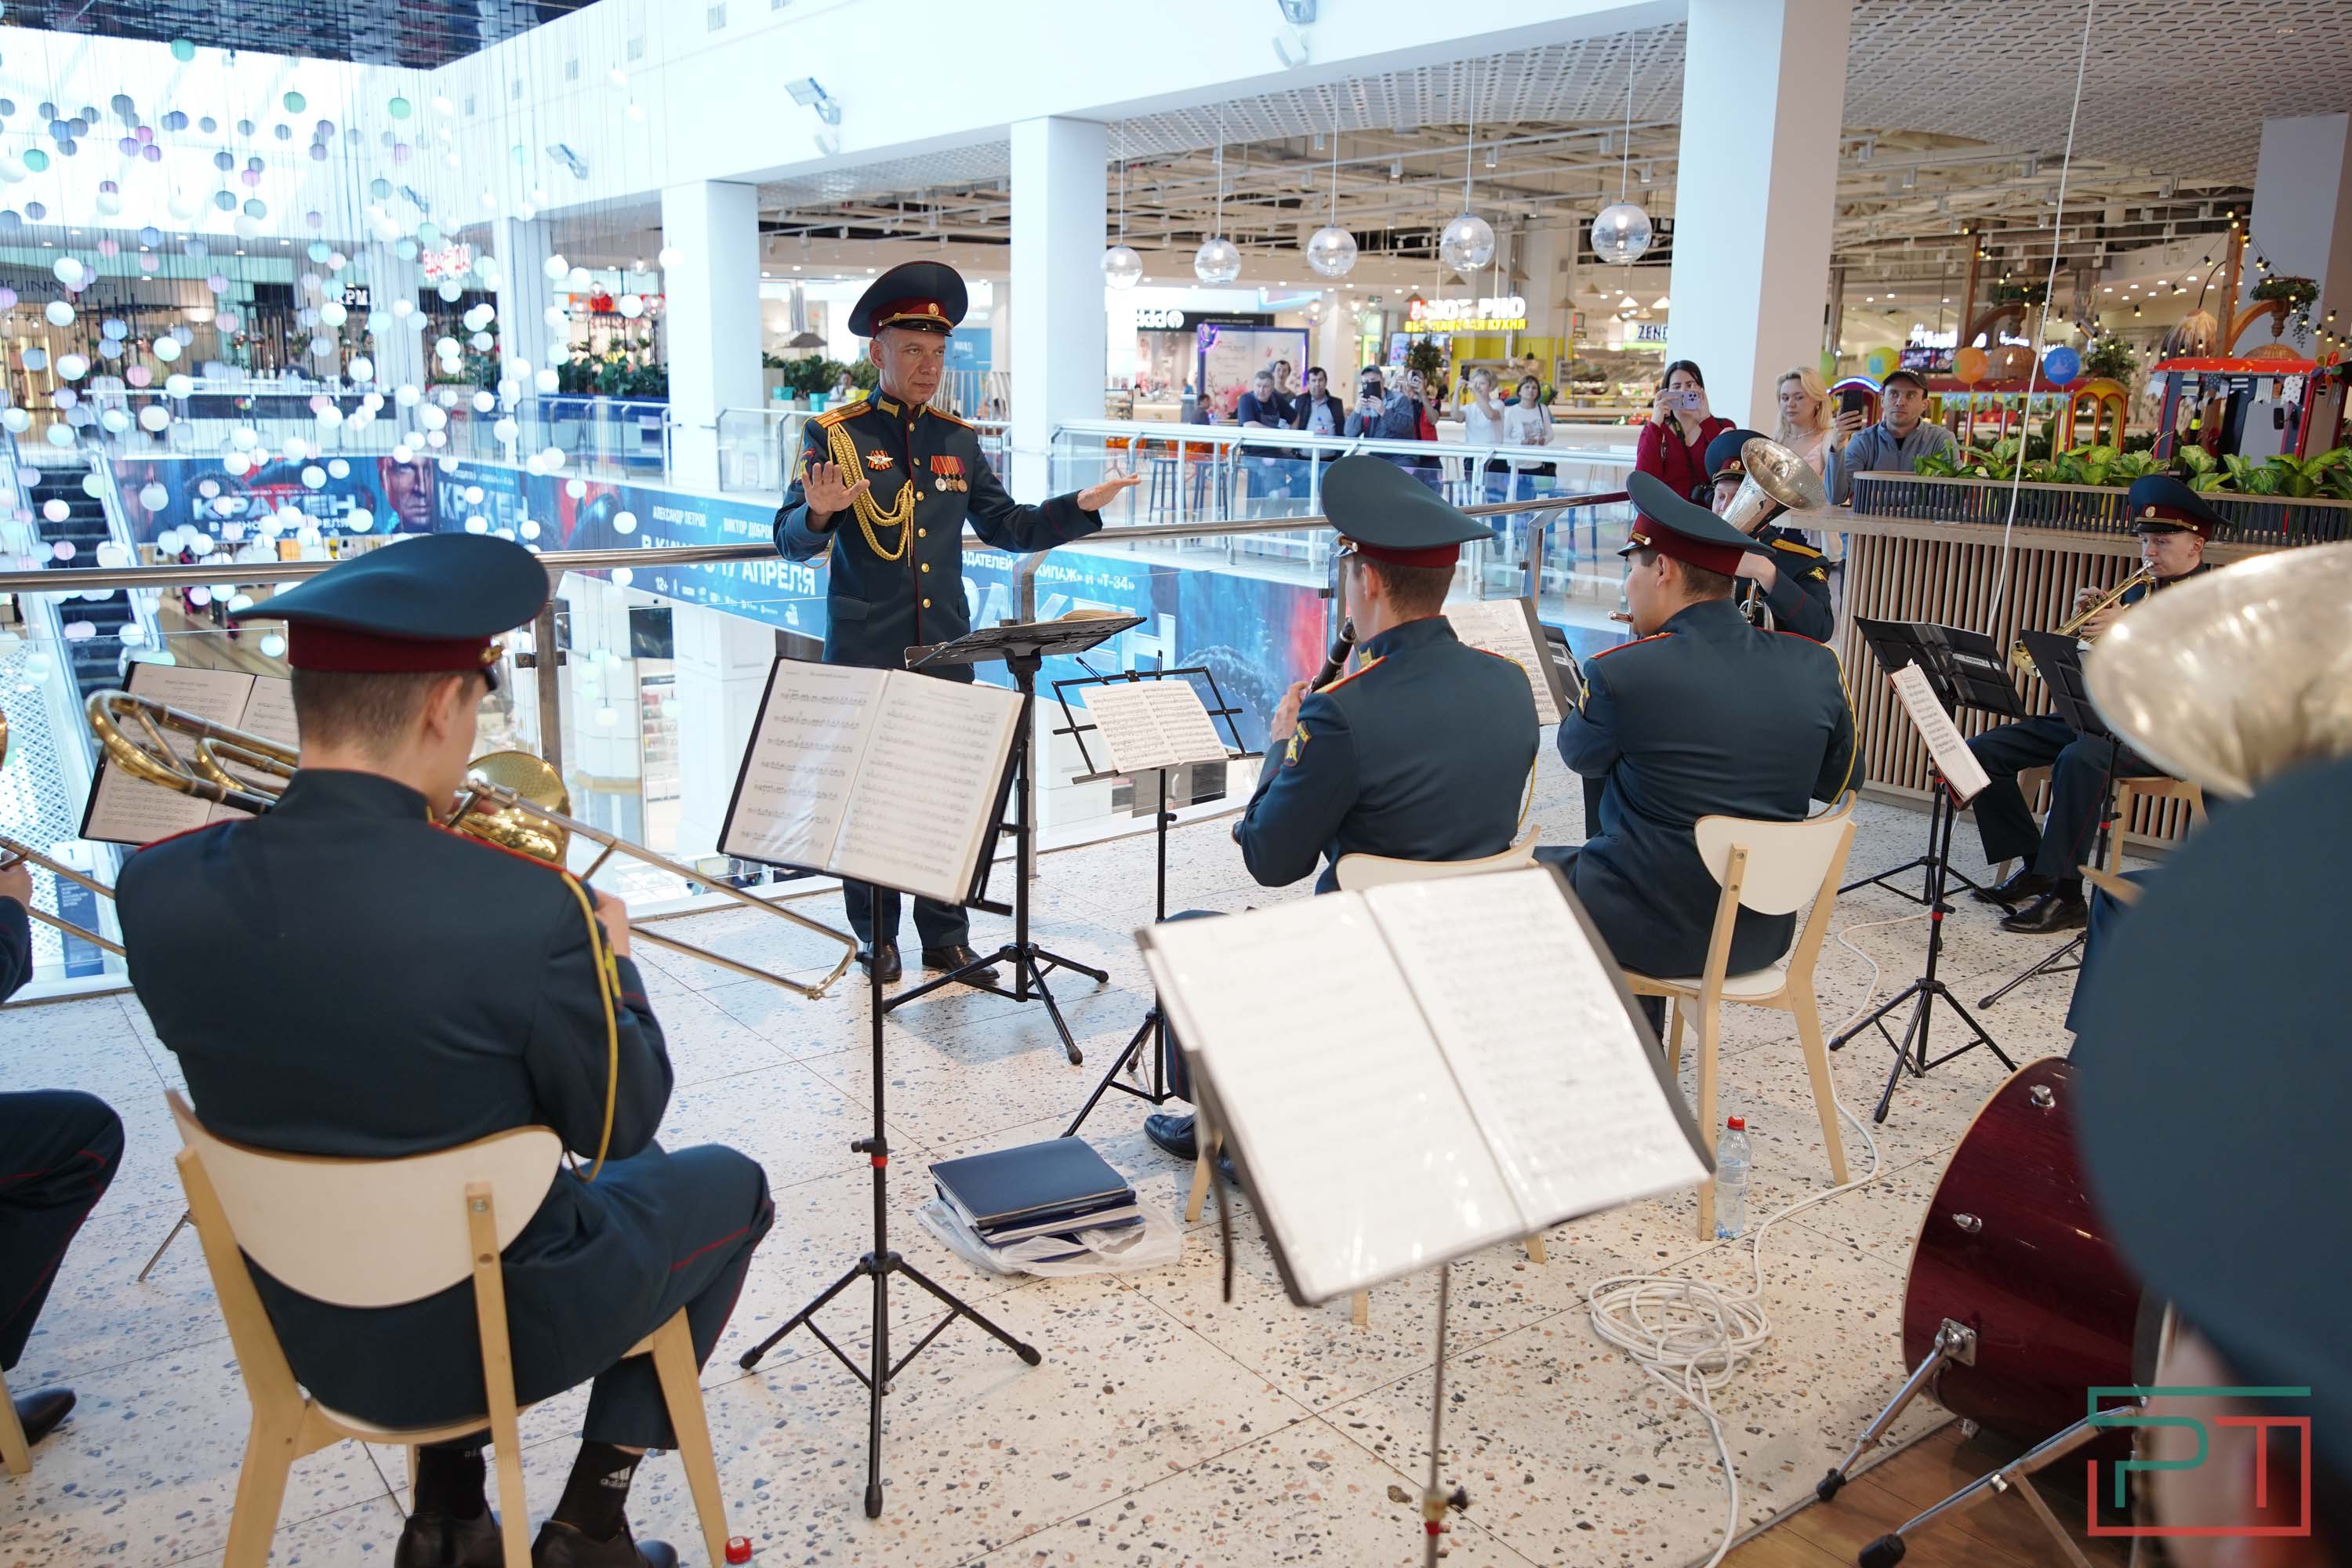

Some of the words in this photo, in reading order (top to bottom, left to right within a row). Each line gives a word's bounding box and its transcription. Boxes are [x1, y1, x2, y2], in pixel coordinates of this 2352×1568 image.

[1487, 318, 1526, 330] КУХНЯ
[439, 481, 528, 533] КРКЕН
[653, 506, 684, 525] АЛЕКСАНДР
[723, 517, 747, 535] ВИКТОР
[748, 521, 773, 540] ДОБРОН
[742, 561, 816, 596] АПРЕЛЯ
[962, 550, 1014, 572] ЗДАТЕЛЕЙ
[1036, 563, 1082, 583] КИПАЖ»
